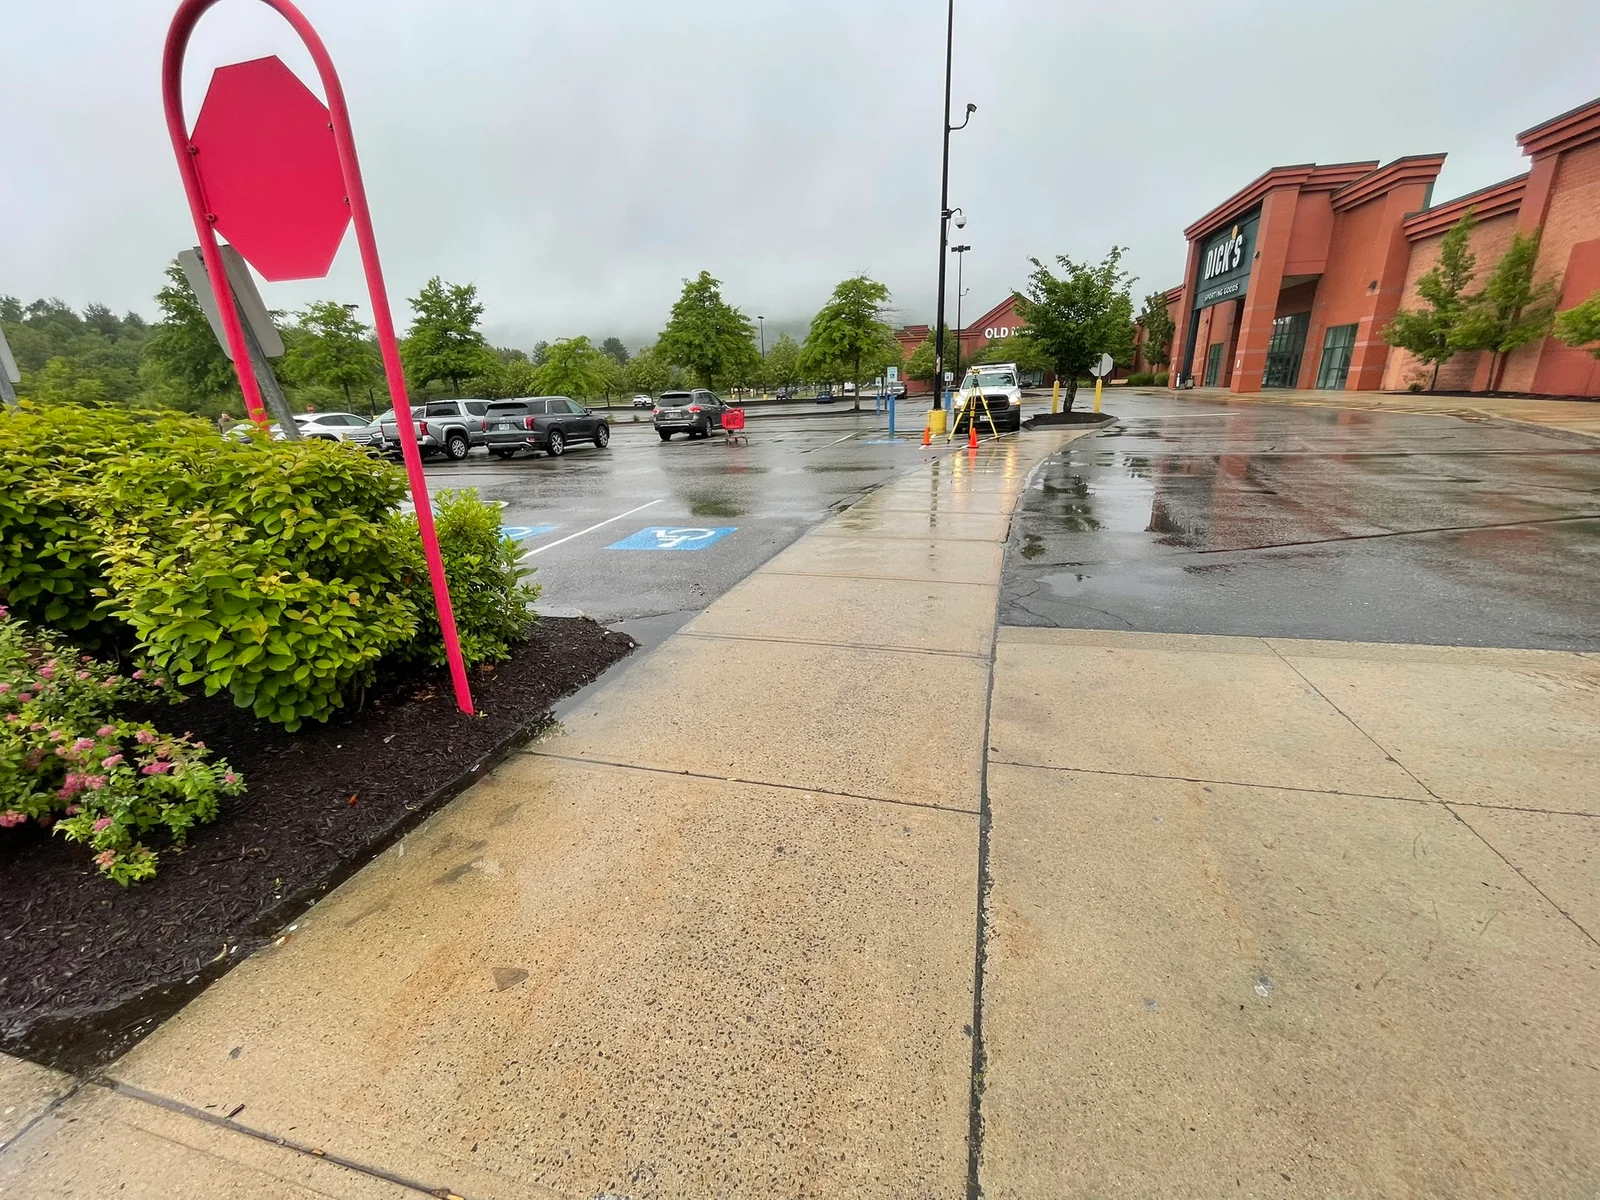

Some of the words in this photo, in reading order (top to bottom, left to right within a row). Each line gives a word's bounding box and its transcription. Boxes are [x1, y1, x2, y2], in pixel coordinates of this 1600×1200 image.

[1204, 234, 1242, 280] DICK'S
[1204, 288, 1223, 301] SPORTING
[1223, 283, 1239, 295] GOODS
[984, 326, 1009, 339] OLD
